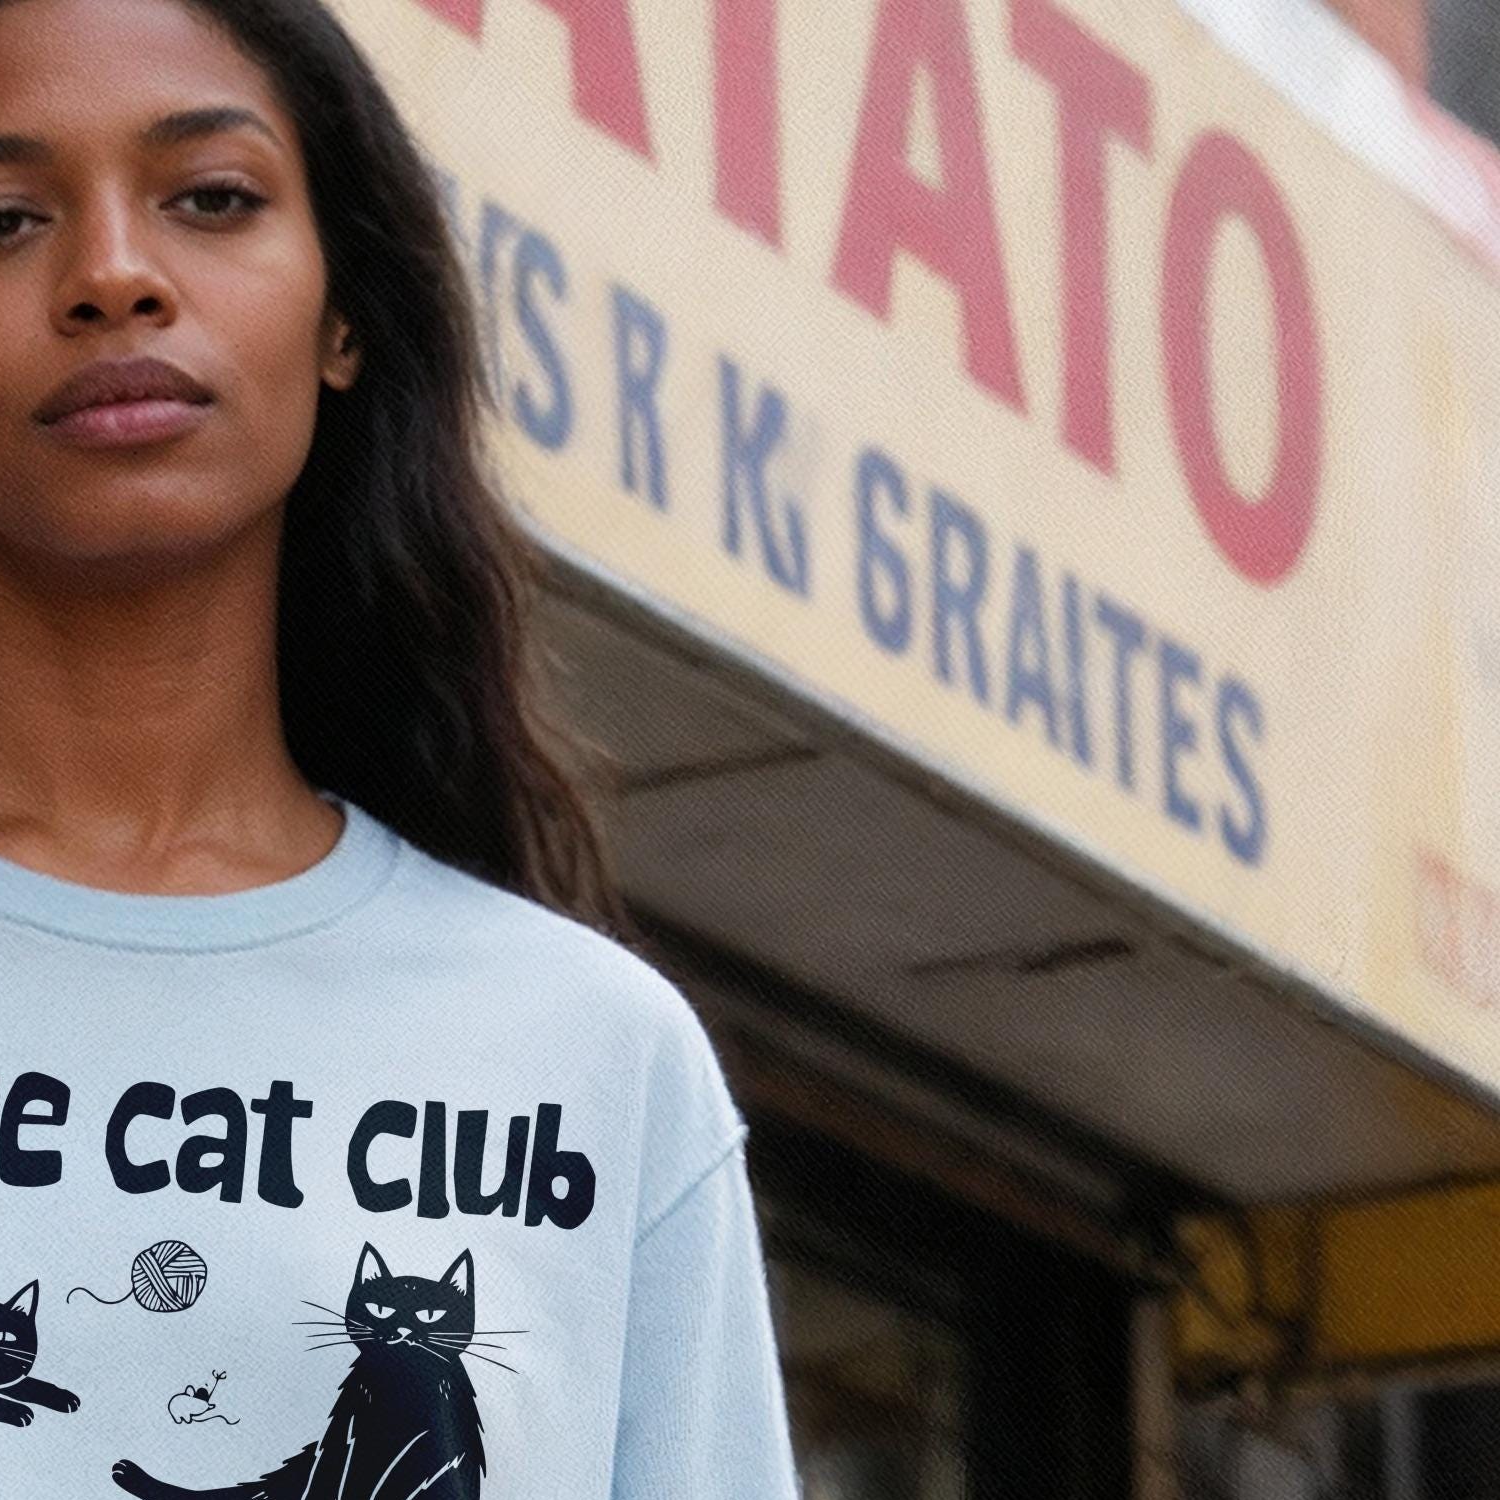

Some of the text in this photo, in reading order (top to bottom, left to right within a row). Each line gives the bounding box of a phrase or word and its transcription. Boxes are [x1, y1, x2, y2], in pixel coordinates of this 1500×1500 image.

[612, 282, 669, 512] R
[105, 1081, 314, 1209] cat
[346, 1099, 597, 1230] club
